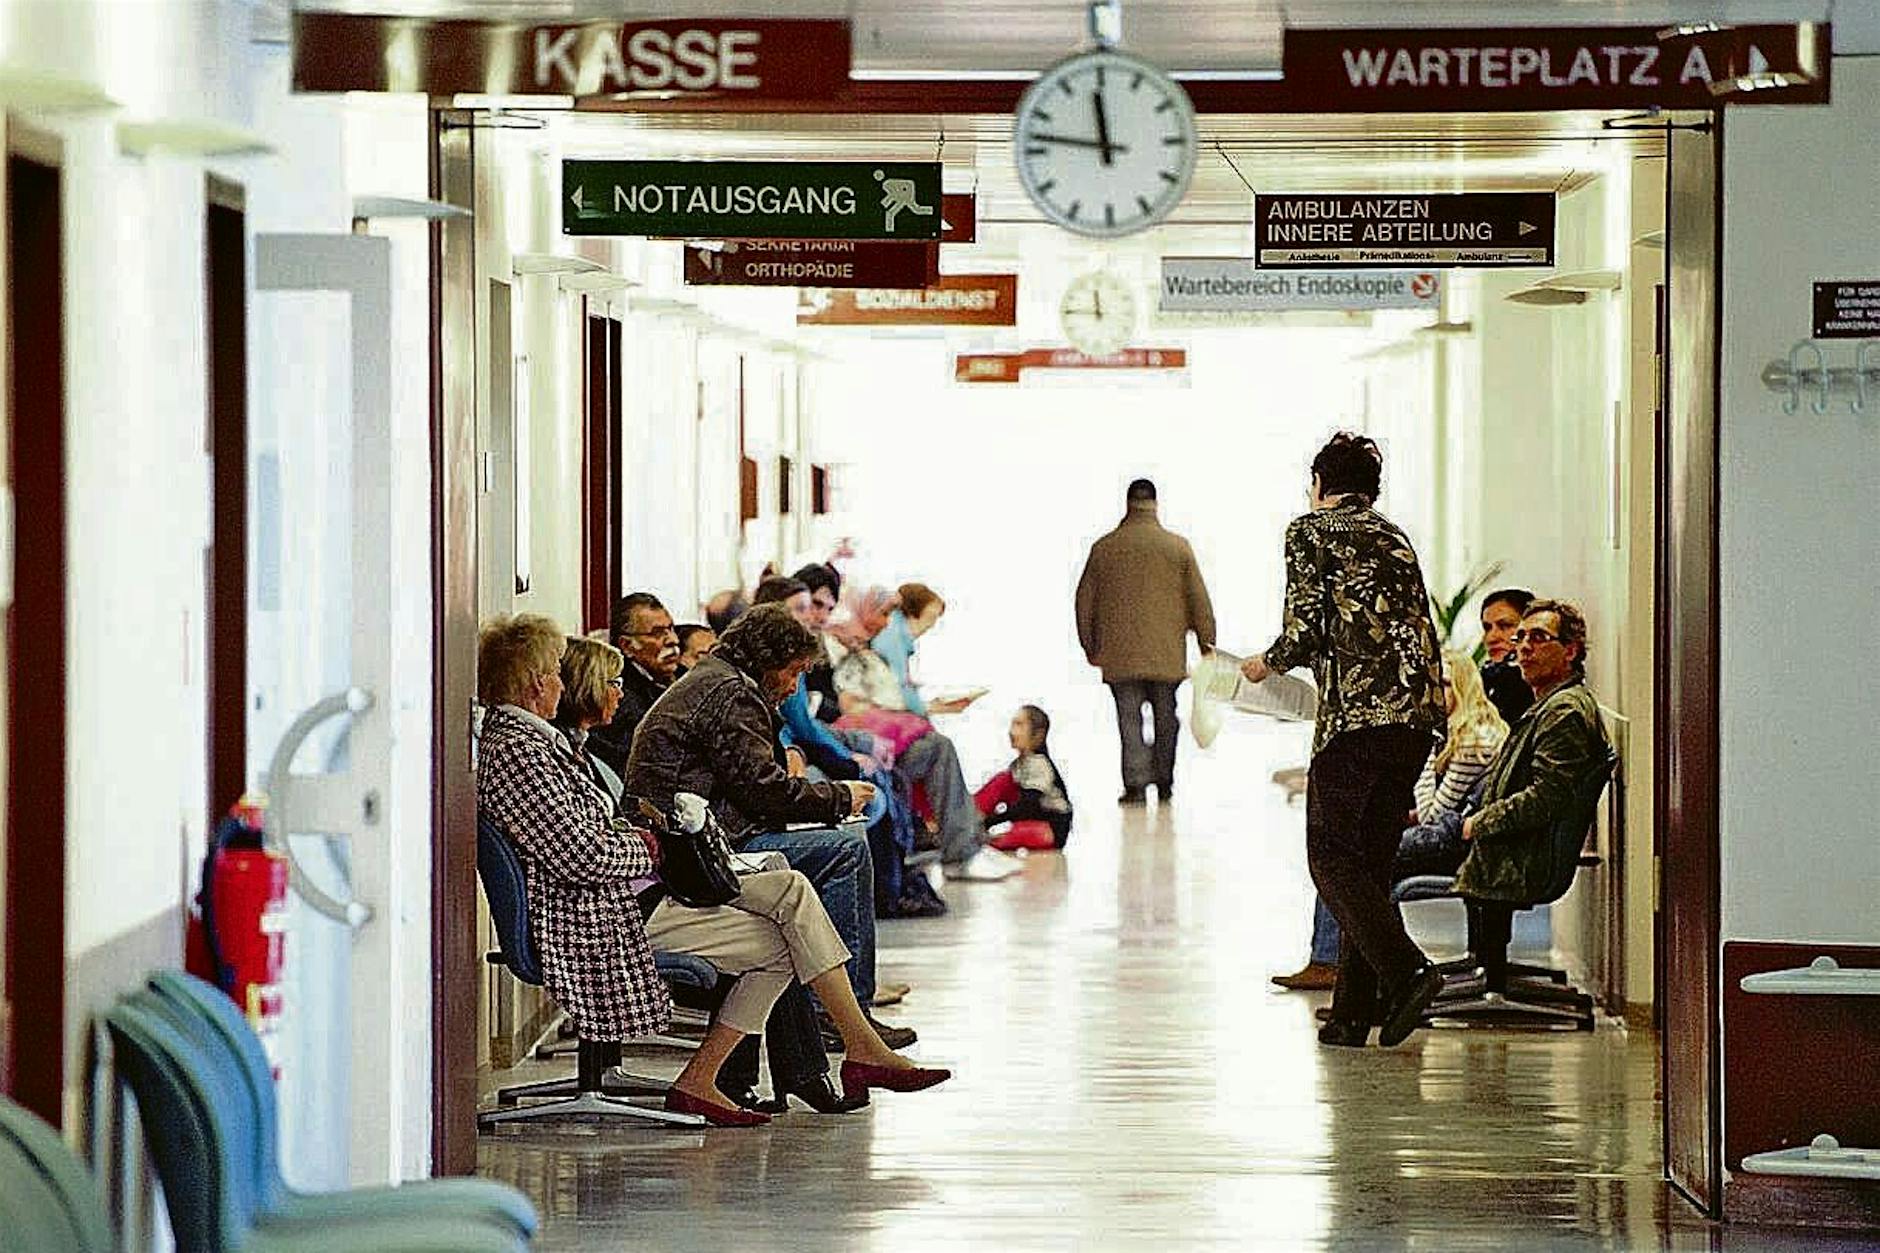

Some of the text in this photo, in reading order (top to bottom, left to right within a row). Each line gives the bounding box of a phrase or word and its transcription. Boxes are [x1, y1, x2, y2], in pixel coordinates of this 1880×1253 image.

[535, 29, 760, 89] KASSE
[1342, 46, 1713, 88] WARTEPLATZ A
[613, 184, 856, 215] NOTAUSGANG
[1267, 199, 1430, 219] AMBULANZEN
[1267, 222, 1494, 242] INNERE ABTEILUNG
[745, 259, 855, 279] ORTHOPÄDIE
[1165, 273, 1405, 299] Wartebereich Endoskopie
